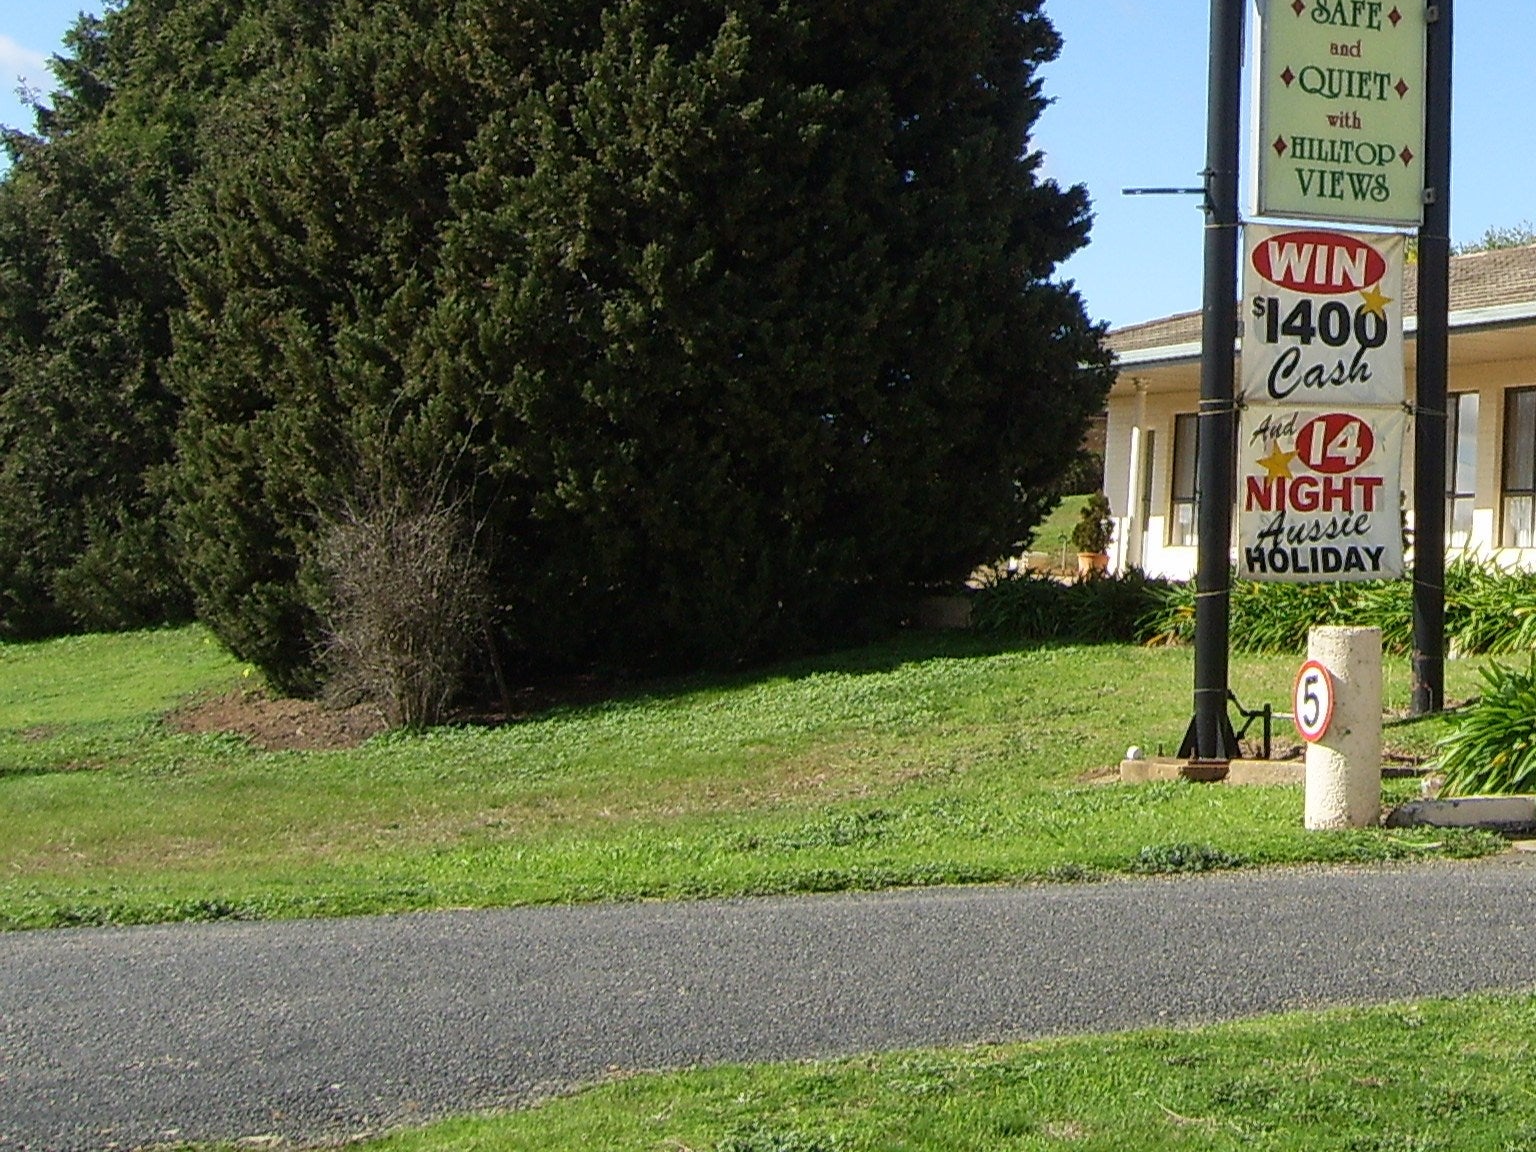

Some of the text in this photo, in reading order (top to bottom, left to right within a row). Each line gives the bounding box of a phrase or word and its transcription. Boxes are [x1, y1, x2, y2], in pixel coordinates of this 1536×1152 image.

[1329, 40, 1362, 59] and
[1299, 65, 1391, 101] QUIET
[1326, 110, 1362, 131] with
[1290, 135, 1396, 167] HILLTOP
[1295, 167, 1390, 203] VIEWS
[1267, 240, 1368, 288] WIN
[1252, 295, 1388, 349] $1400
[1267, 345, 1372, 399] Cash
[1250, 412, 1364, 467] And 14
[1245, 475, 1384, 513] NIGHT
[1254, 509, 1372, 551] Aussie
[1245, 545, 1385, 574] HOLIDAY
[1303, 675, 1320, 727] 5
